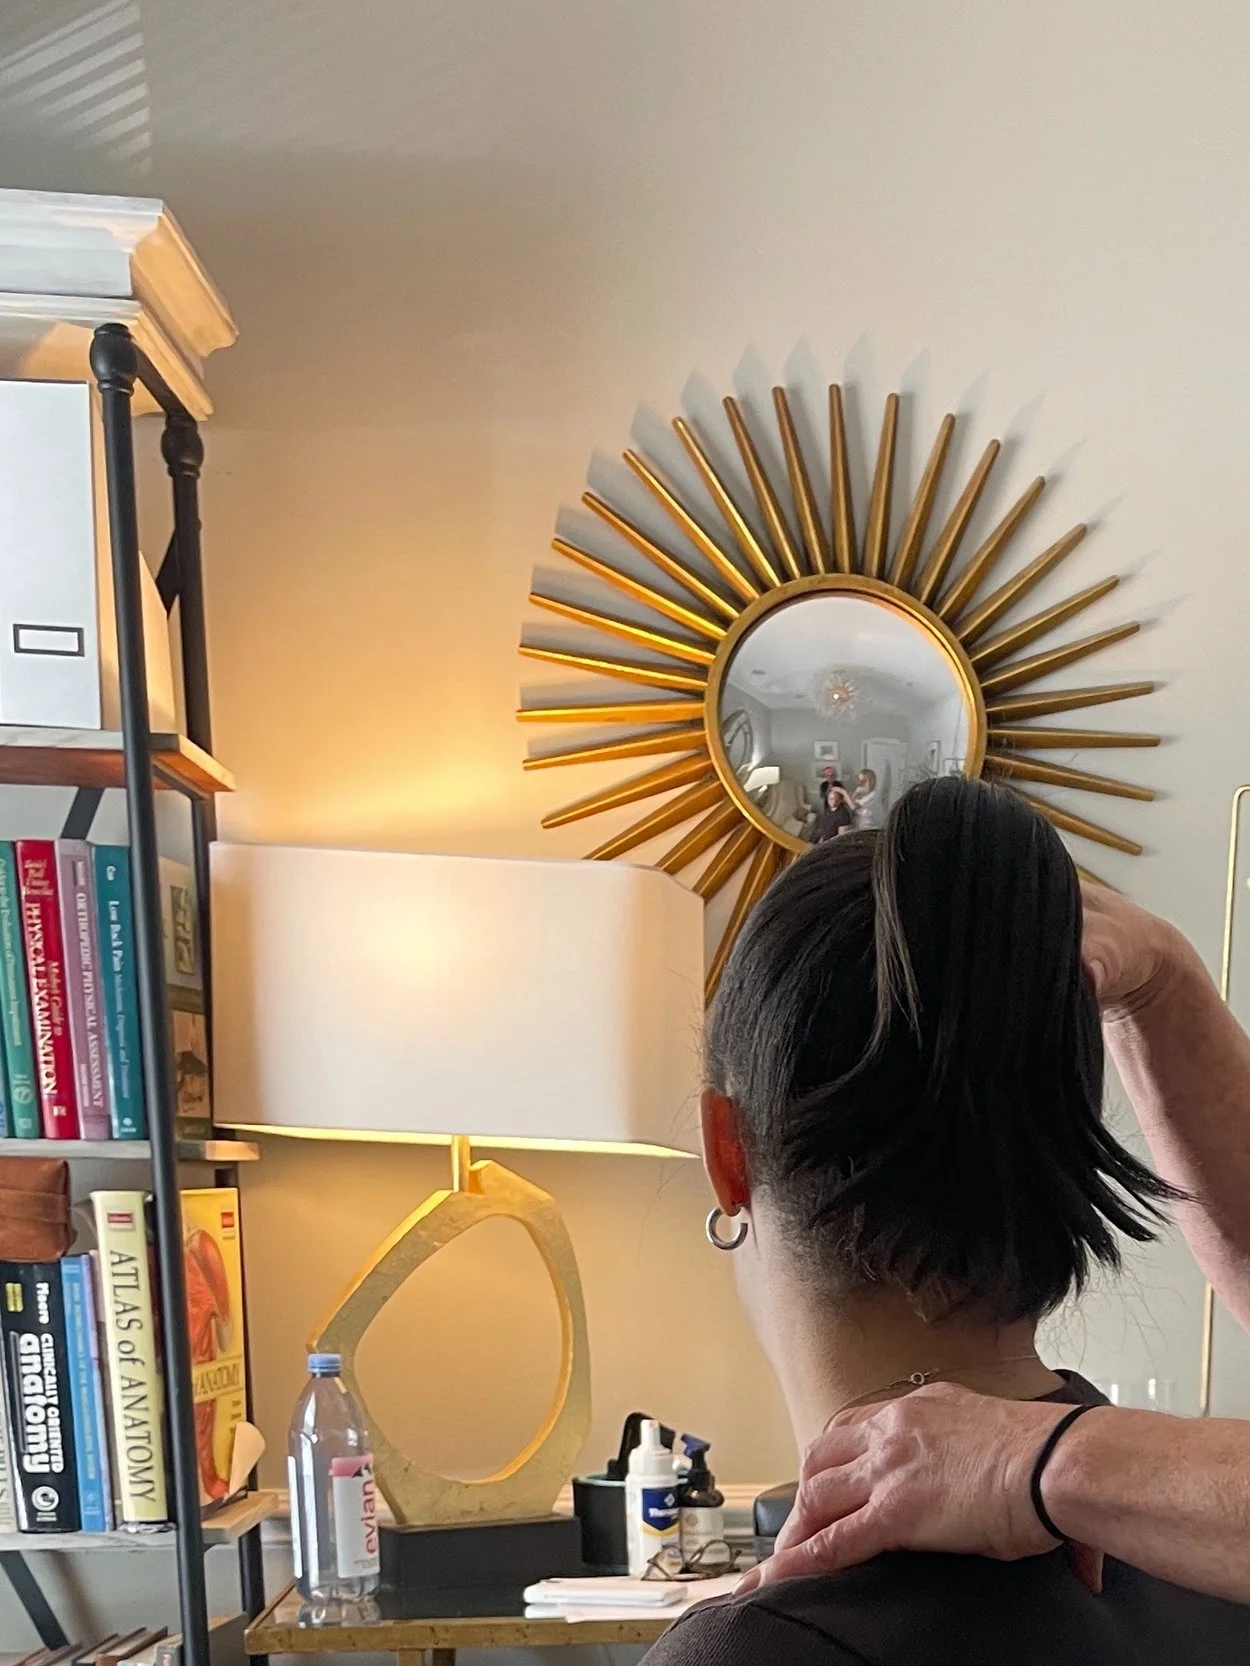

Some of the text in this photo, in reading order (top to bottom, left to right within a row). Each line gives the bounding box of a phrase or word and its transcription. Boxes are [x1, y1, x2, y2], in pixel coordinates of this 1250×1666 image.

[26, 902, 45, 974] PHYSICAL
[108, 901, 120, 921] Low
[110, 924, 122, 947] Back
[112, 949, 124, 971] Pain
[33, 976, 57, 1095] EXAMINATION
[82, 971, 98, 1028] PHYSICAL
[87, 1031, 104, 1108] ASSESSMENT
[35, 1282, 50, 1325] Moore
[19, 1332, 51, 1474] anatomy
[40, 1332, 65, 1474] CLINICALLY ORIENTED
[110, 1250, 156, 1503] ATLAS of ANATOMY
[360, 1479, 377, 1554] evian
